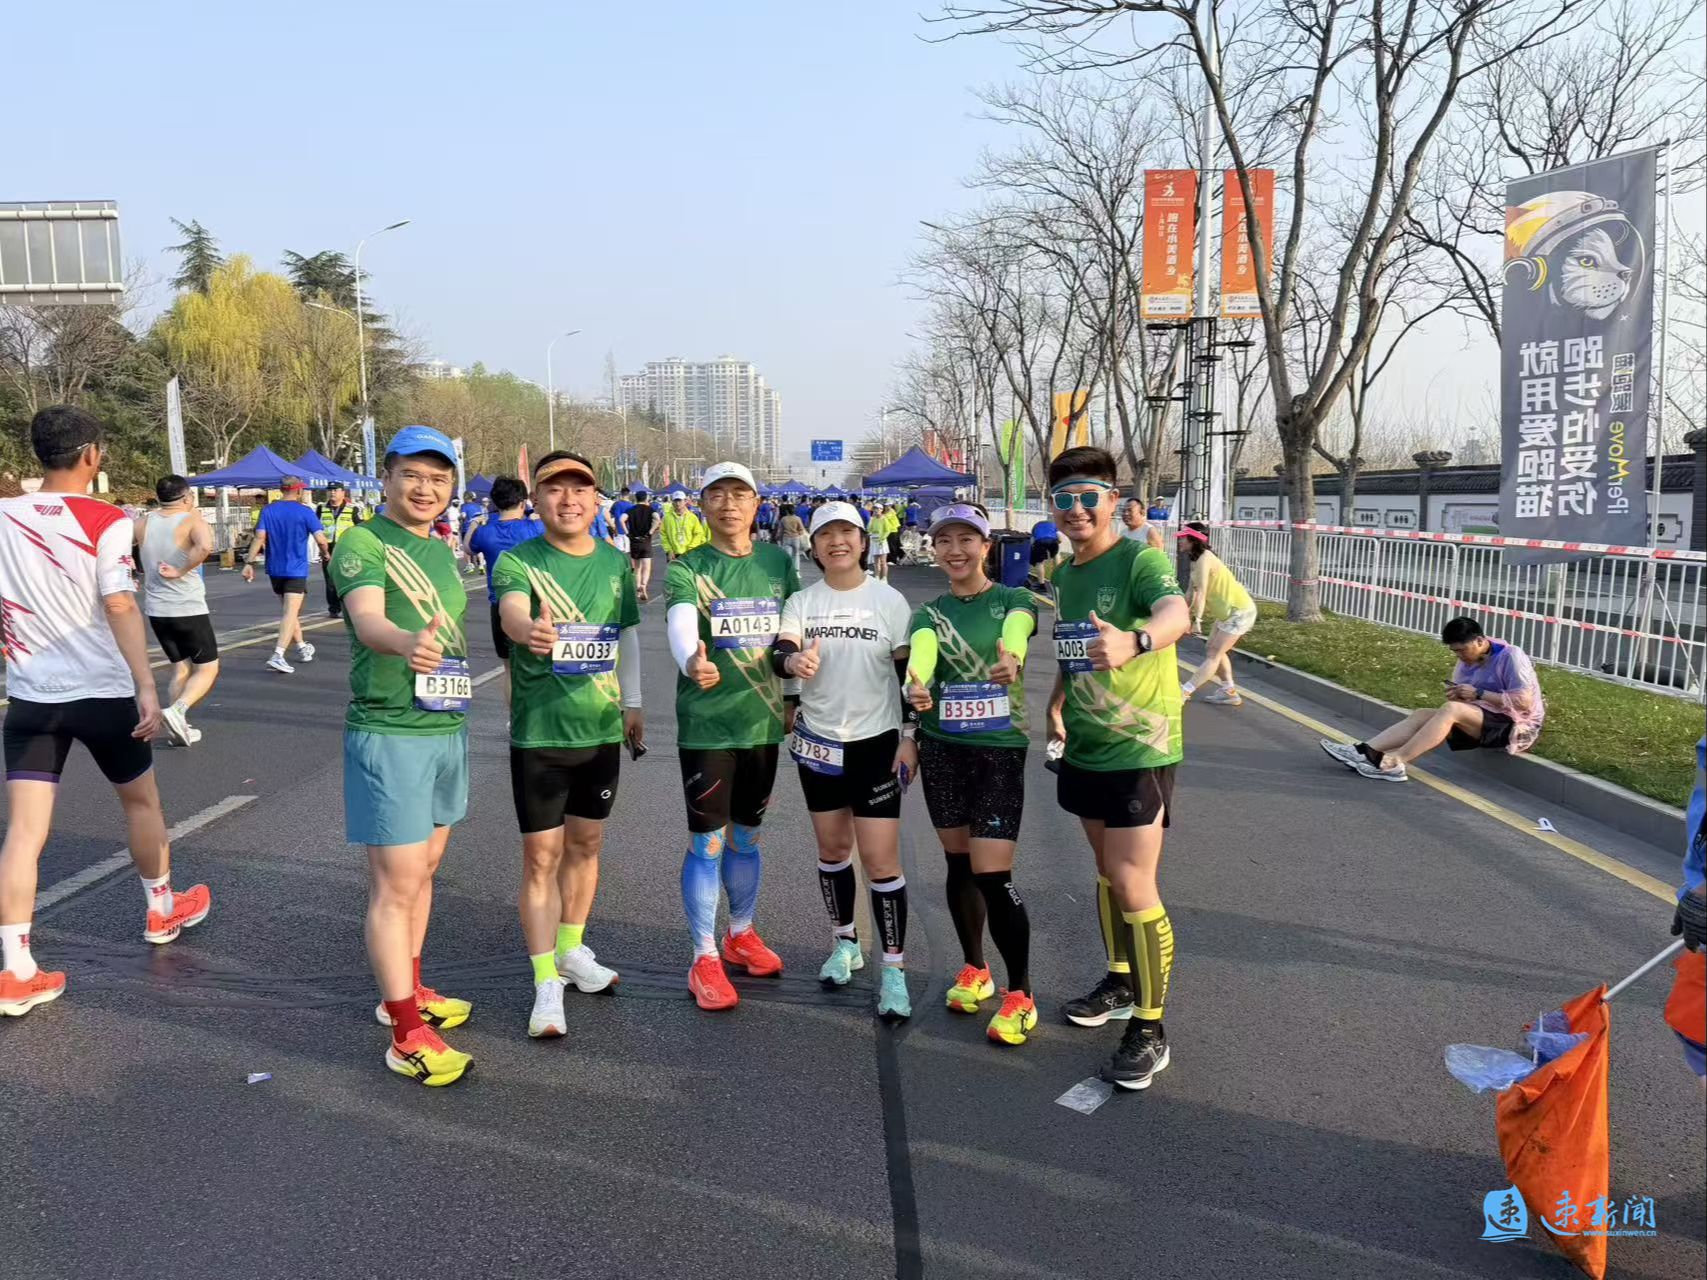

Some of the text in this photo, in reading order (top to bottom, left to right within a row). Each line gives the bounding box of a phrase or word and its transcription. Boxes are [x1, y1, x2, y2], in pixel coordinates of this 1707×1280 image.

[719, 616, 772, 635] A0143
[804, 626, 879, 641] MARATHONER
[561, 642, 611, 659] A0033
[1058, 640, 1088, 658] A003
[426, 676, 469, 696] B3166
[944, 699, 995, 718] B3591
[791, 734, 831, 762] B3782
